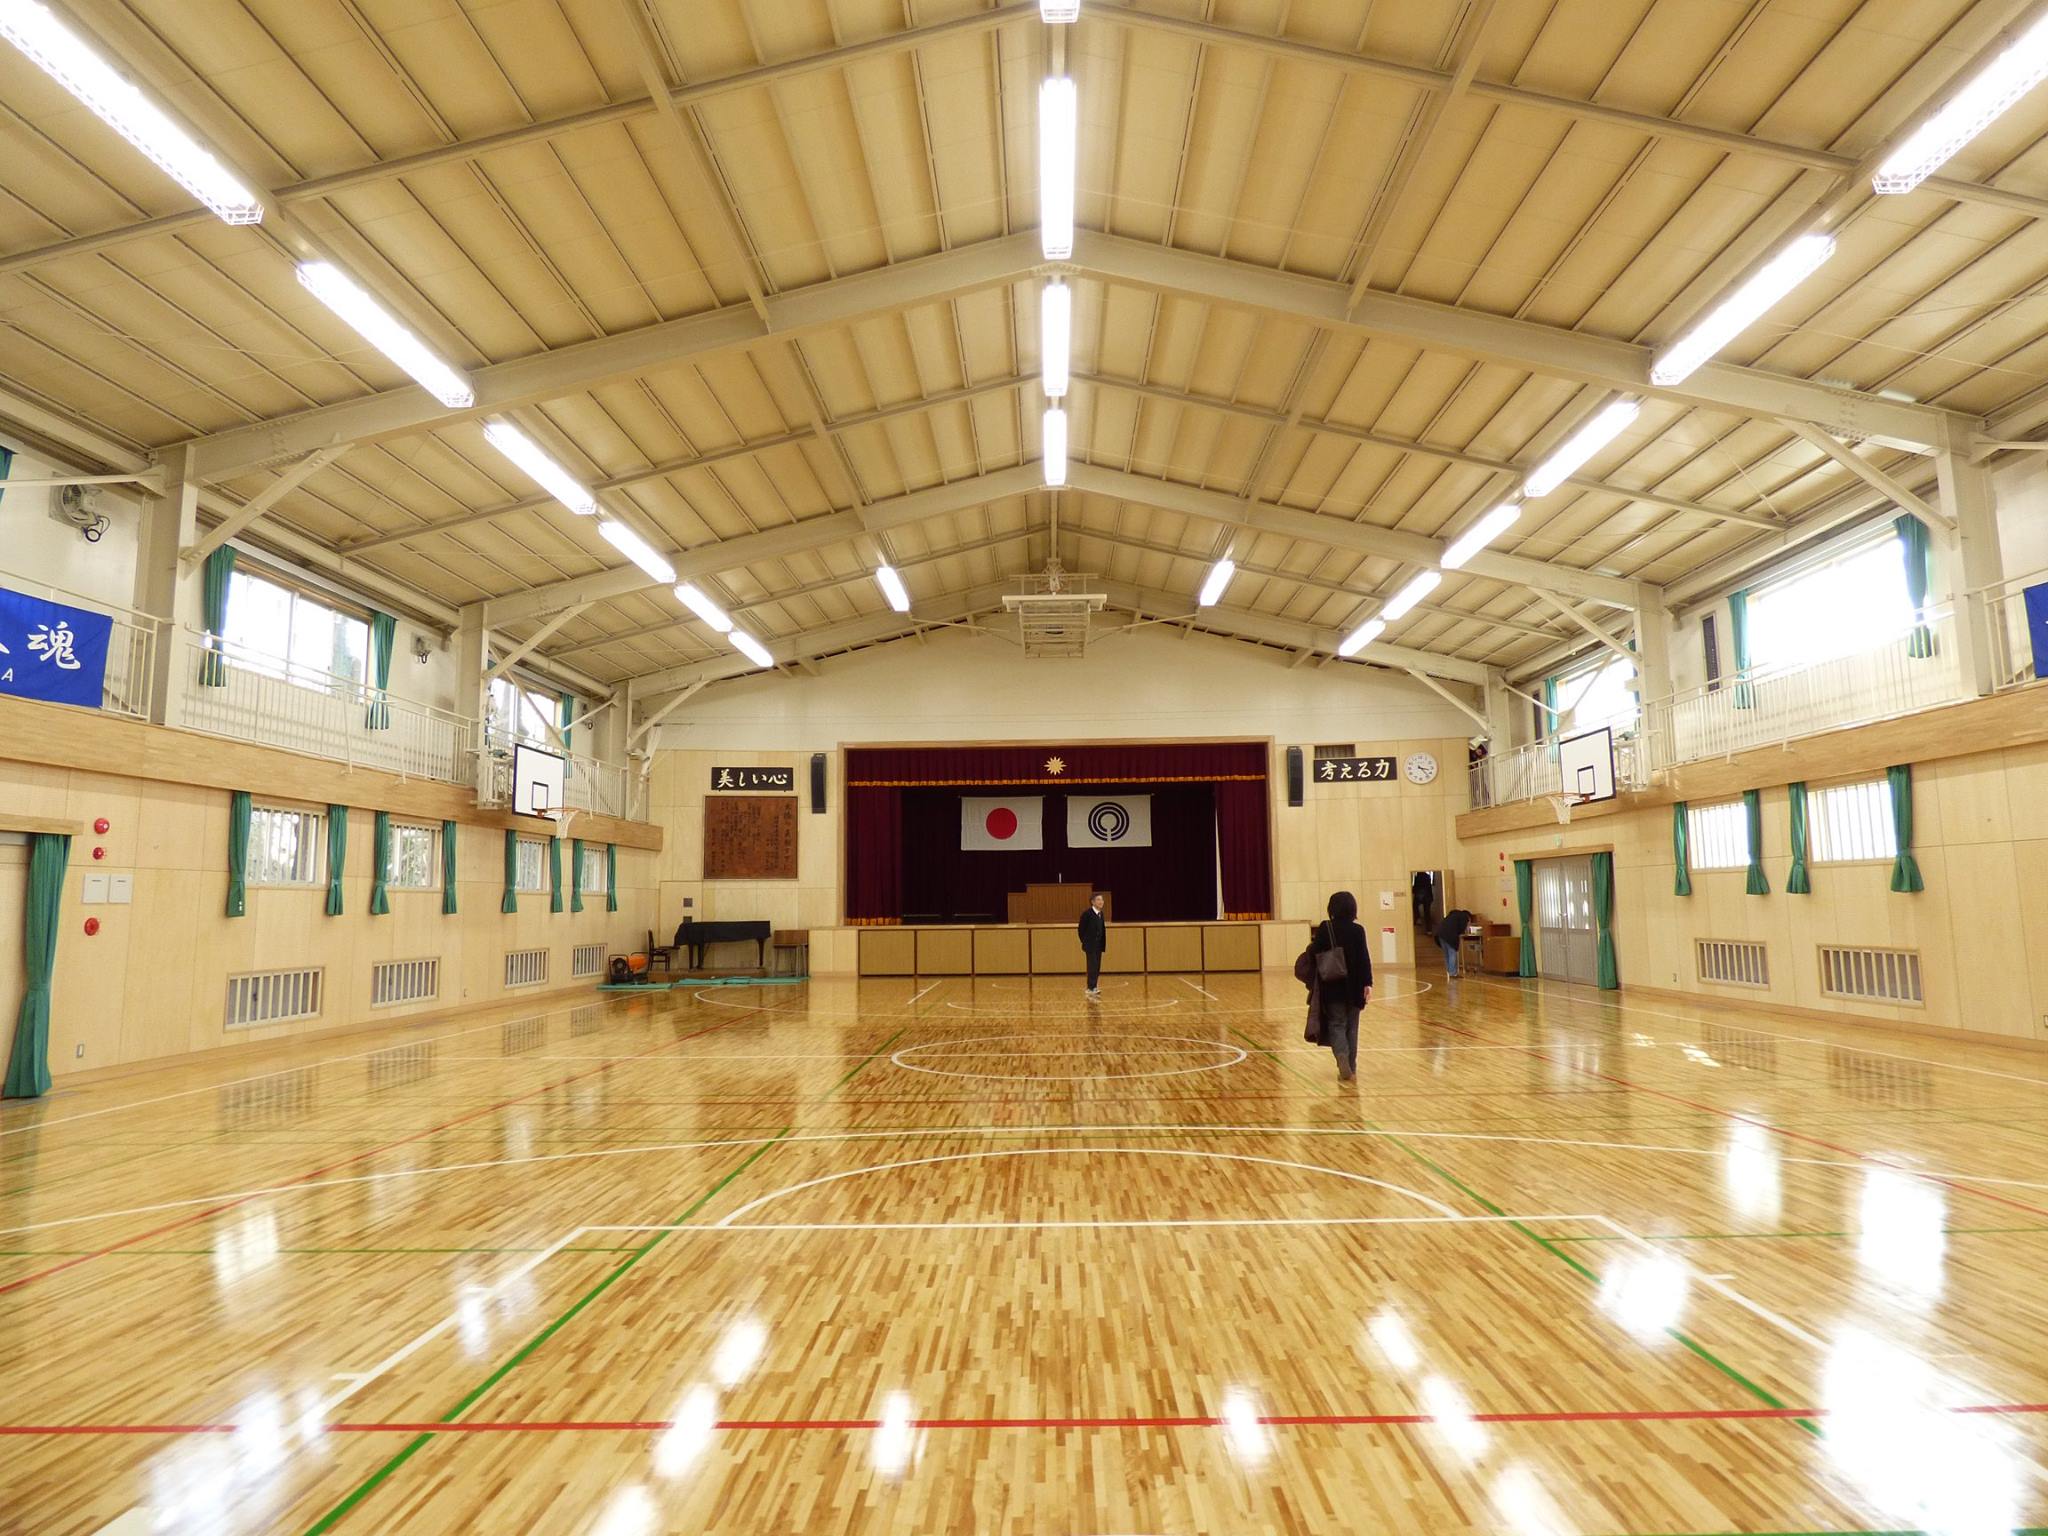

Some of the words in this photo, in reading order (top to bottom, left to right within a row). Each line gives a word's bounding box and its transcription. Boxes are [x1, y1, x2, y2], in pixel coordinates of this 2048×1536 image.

[0, 621, 81, 670] 魂
[717, 768, 788, 788] 美しい心
[1320, 759, 1390, 780] 考える力
